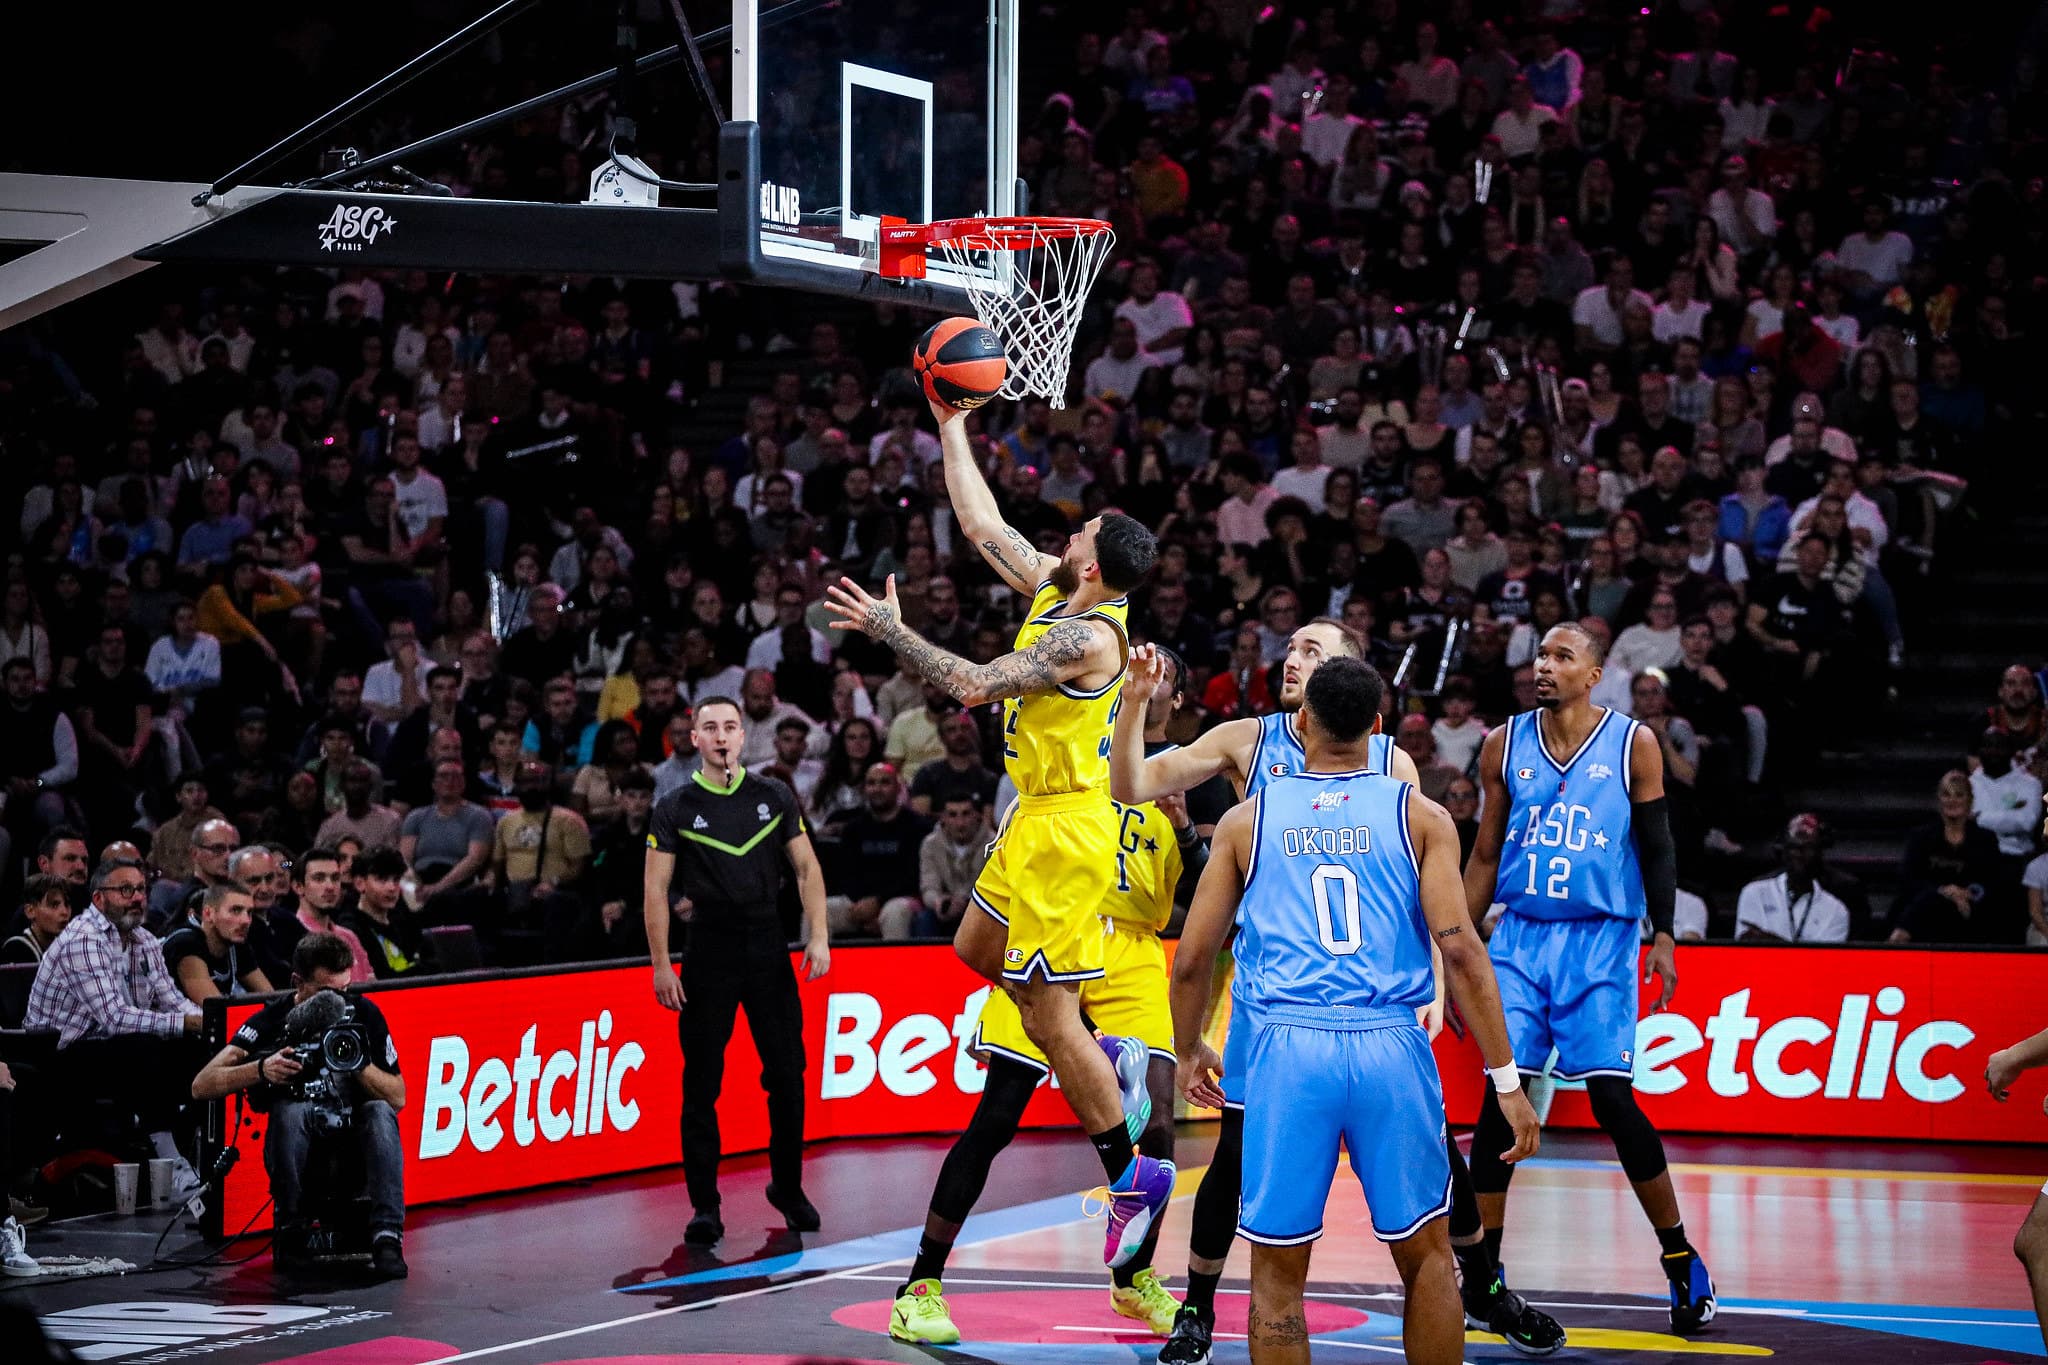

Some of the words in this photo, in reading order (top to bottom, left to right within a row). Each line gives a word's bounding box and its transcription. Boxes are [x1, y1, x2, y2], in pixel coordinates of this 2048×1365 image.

[318, 204, 384, 245] ASG
[771, 184, 801, 226] LNB
[337, 242, 362, 251] PARIS
[1311, 791, 1344, 808] ASG
[1283, 826, 1371, 857] OKOBO
[1520, 801, 1592, 852] ASG
[1524, 852, 1571, 900] 12
[1310, 864, 1363, 956] 0
[1550, 986, 1976, 1104] etclic
[418, 1009, 646, 1160] Betclic
